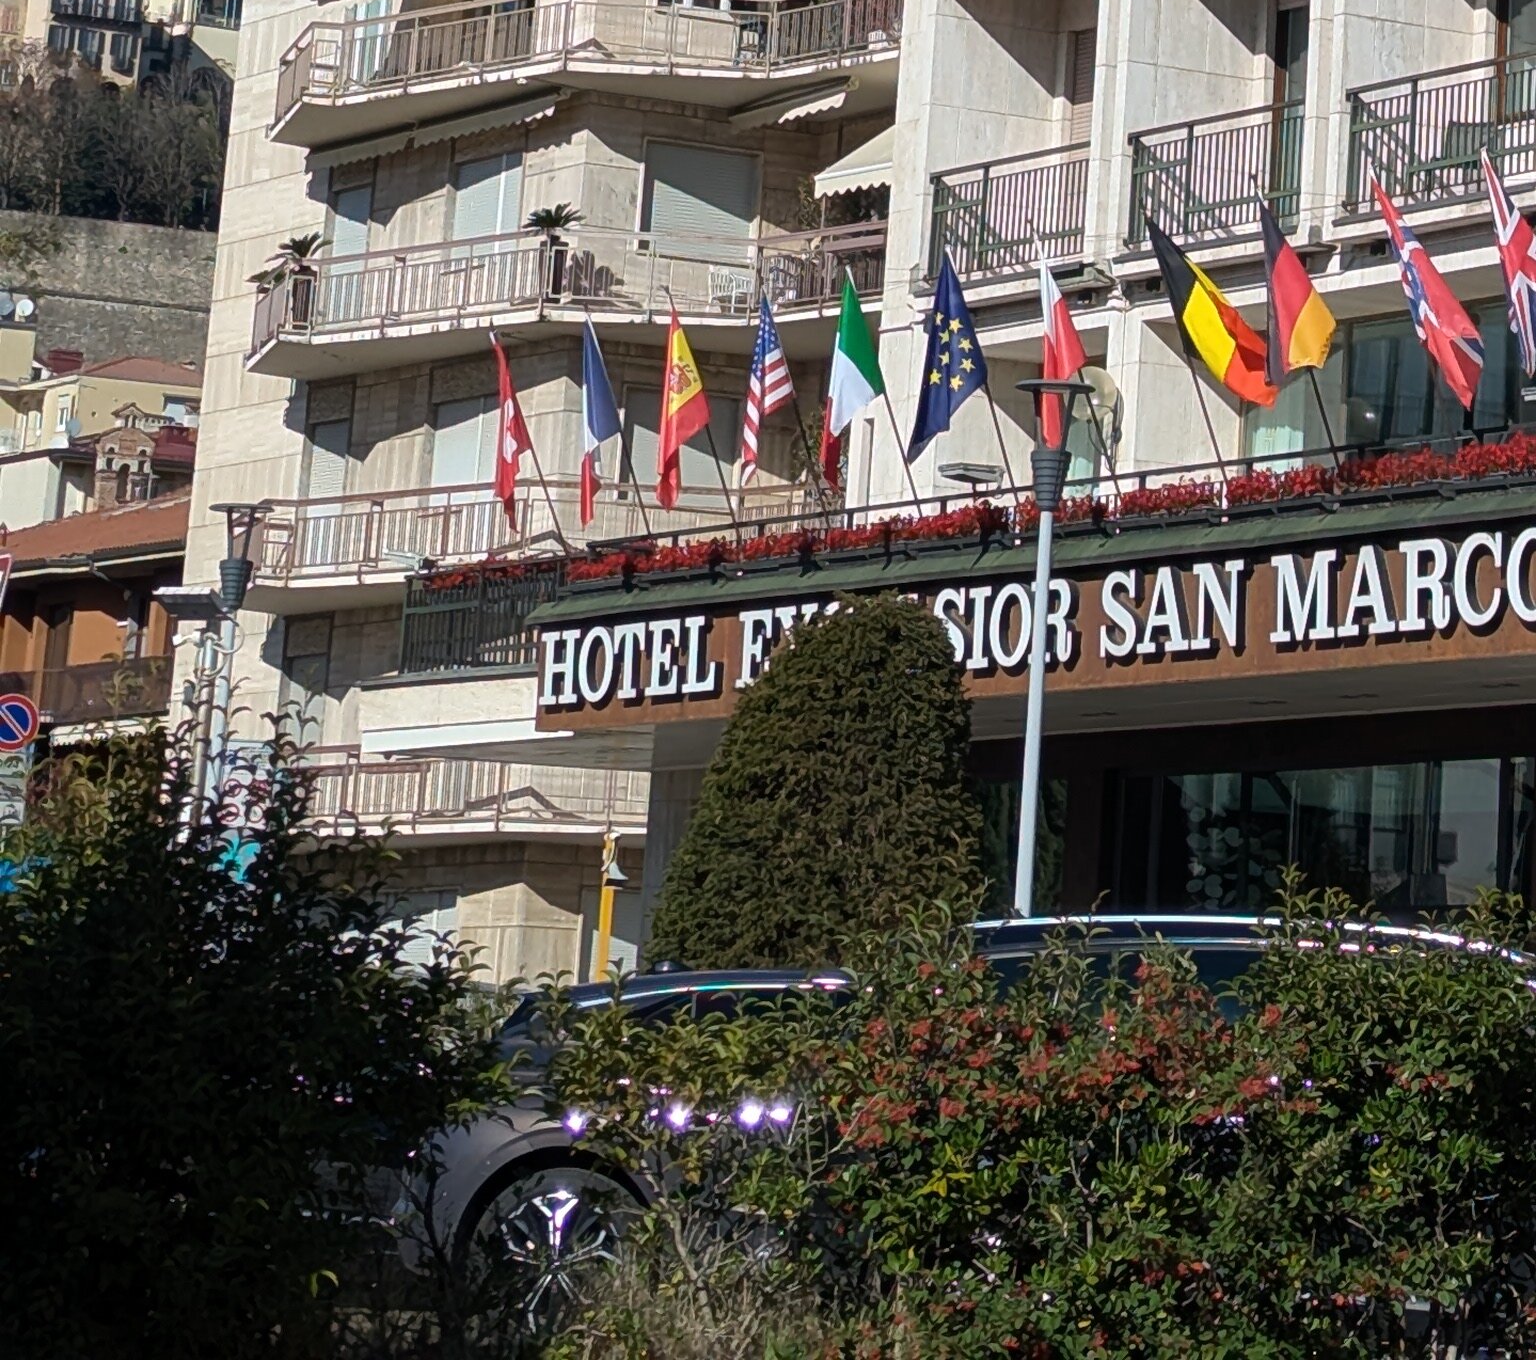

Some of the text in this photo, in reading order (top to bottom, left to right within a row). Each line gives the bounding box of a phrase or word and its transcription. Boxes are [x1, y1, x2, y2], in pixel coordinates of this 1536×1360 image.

[538, 615, 716, 707] HOTEL
[735, 577, 1073, 689] ESIOR
[1100, 560, 1244, 658] SAN
